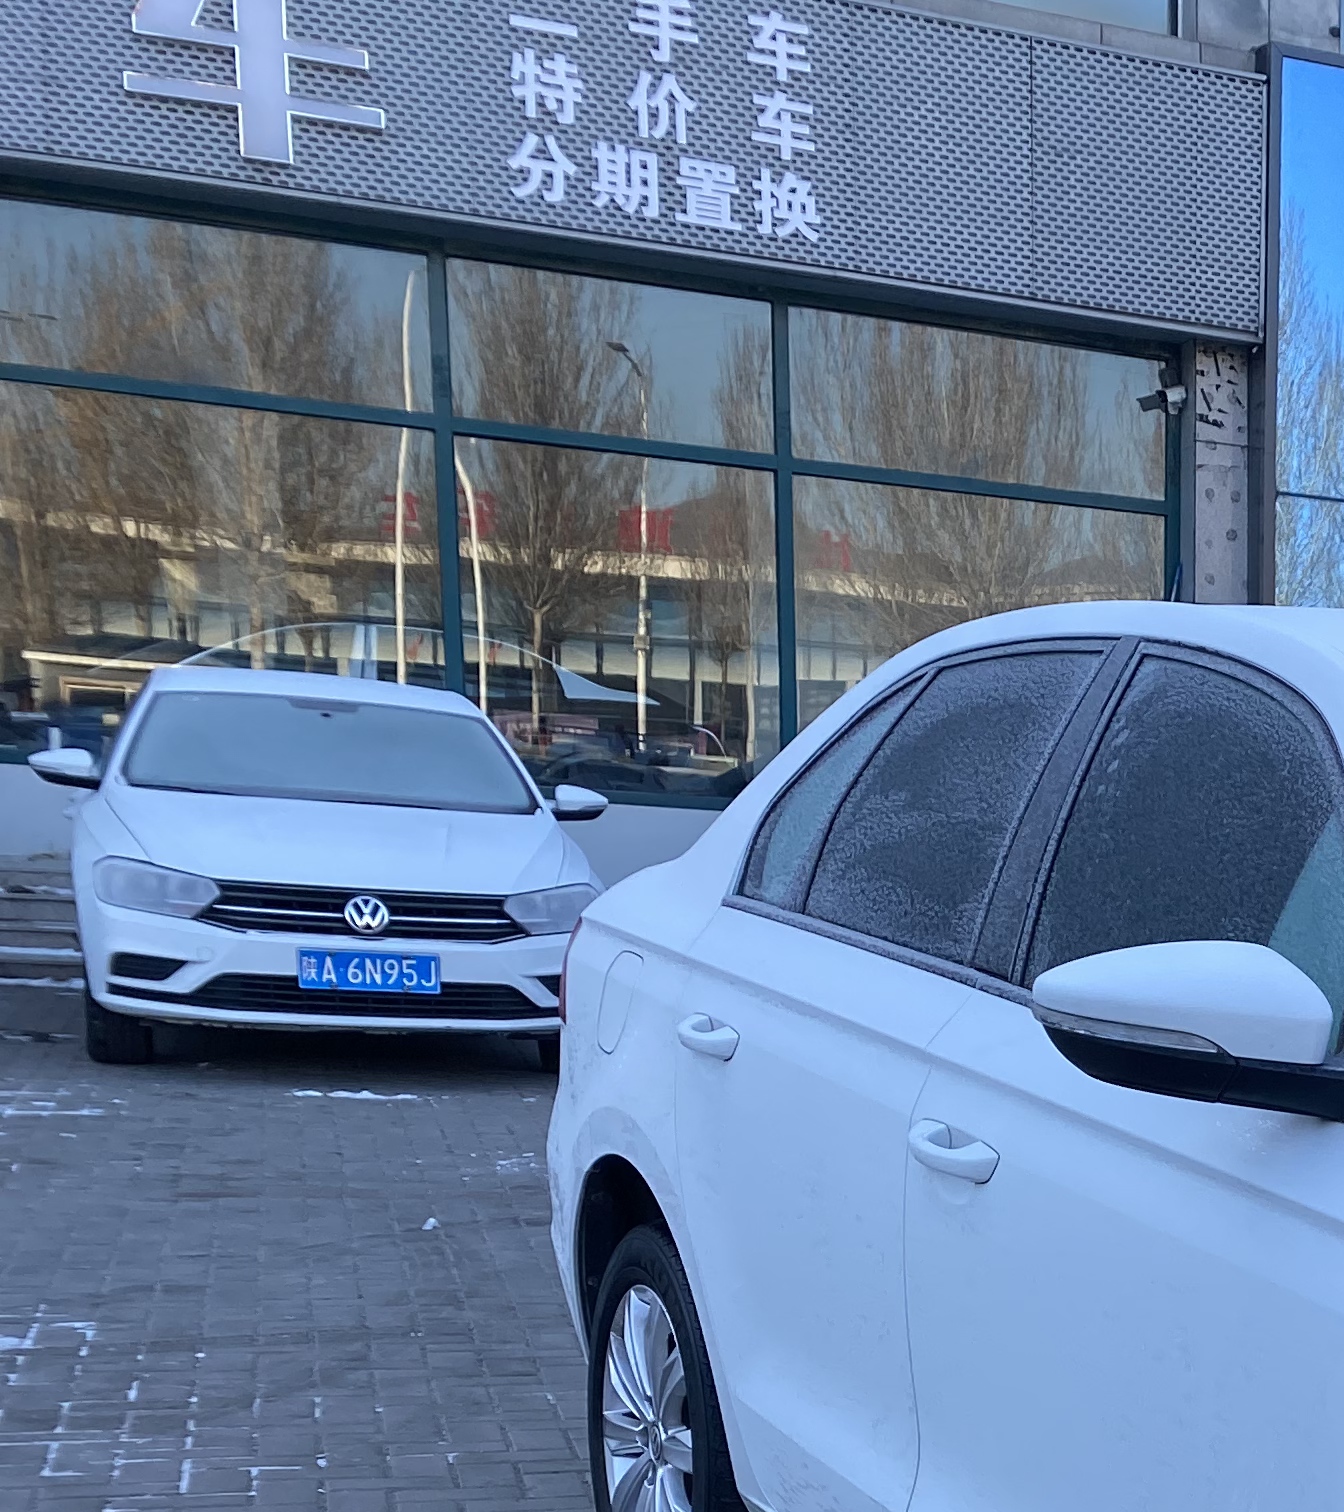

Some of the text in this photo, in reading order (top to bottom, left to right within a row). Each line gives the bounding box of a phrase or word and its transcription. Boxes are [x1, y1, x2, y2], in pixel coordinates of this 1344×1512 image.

[510, 47, 816, 161] 特价车
[507, 132, 821, 243] 分期置换
